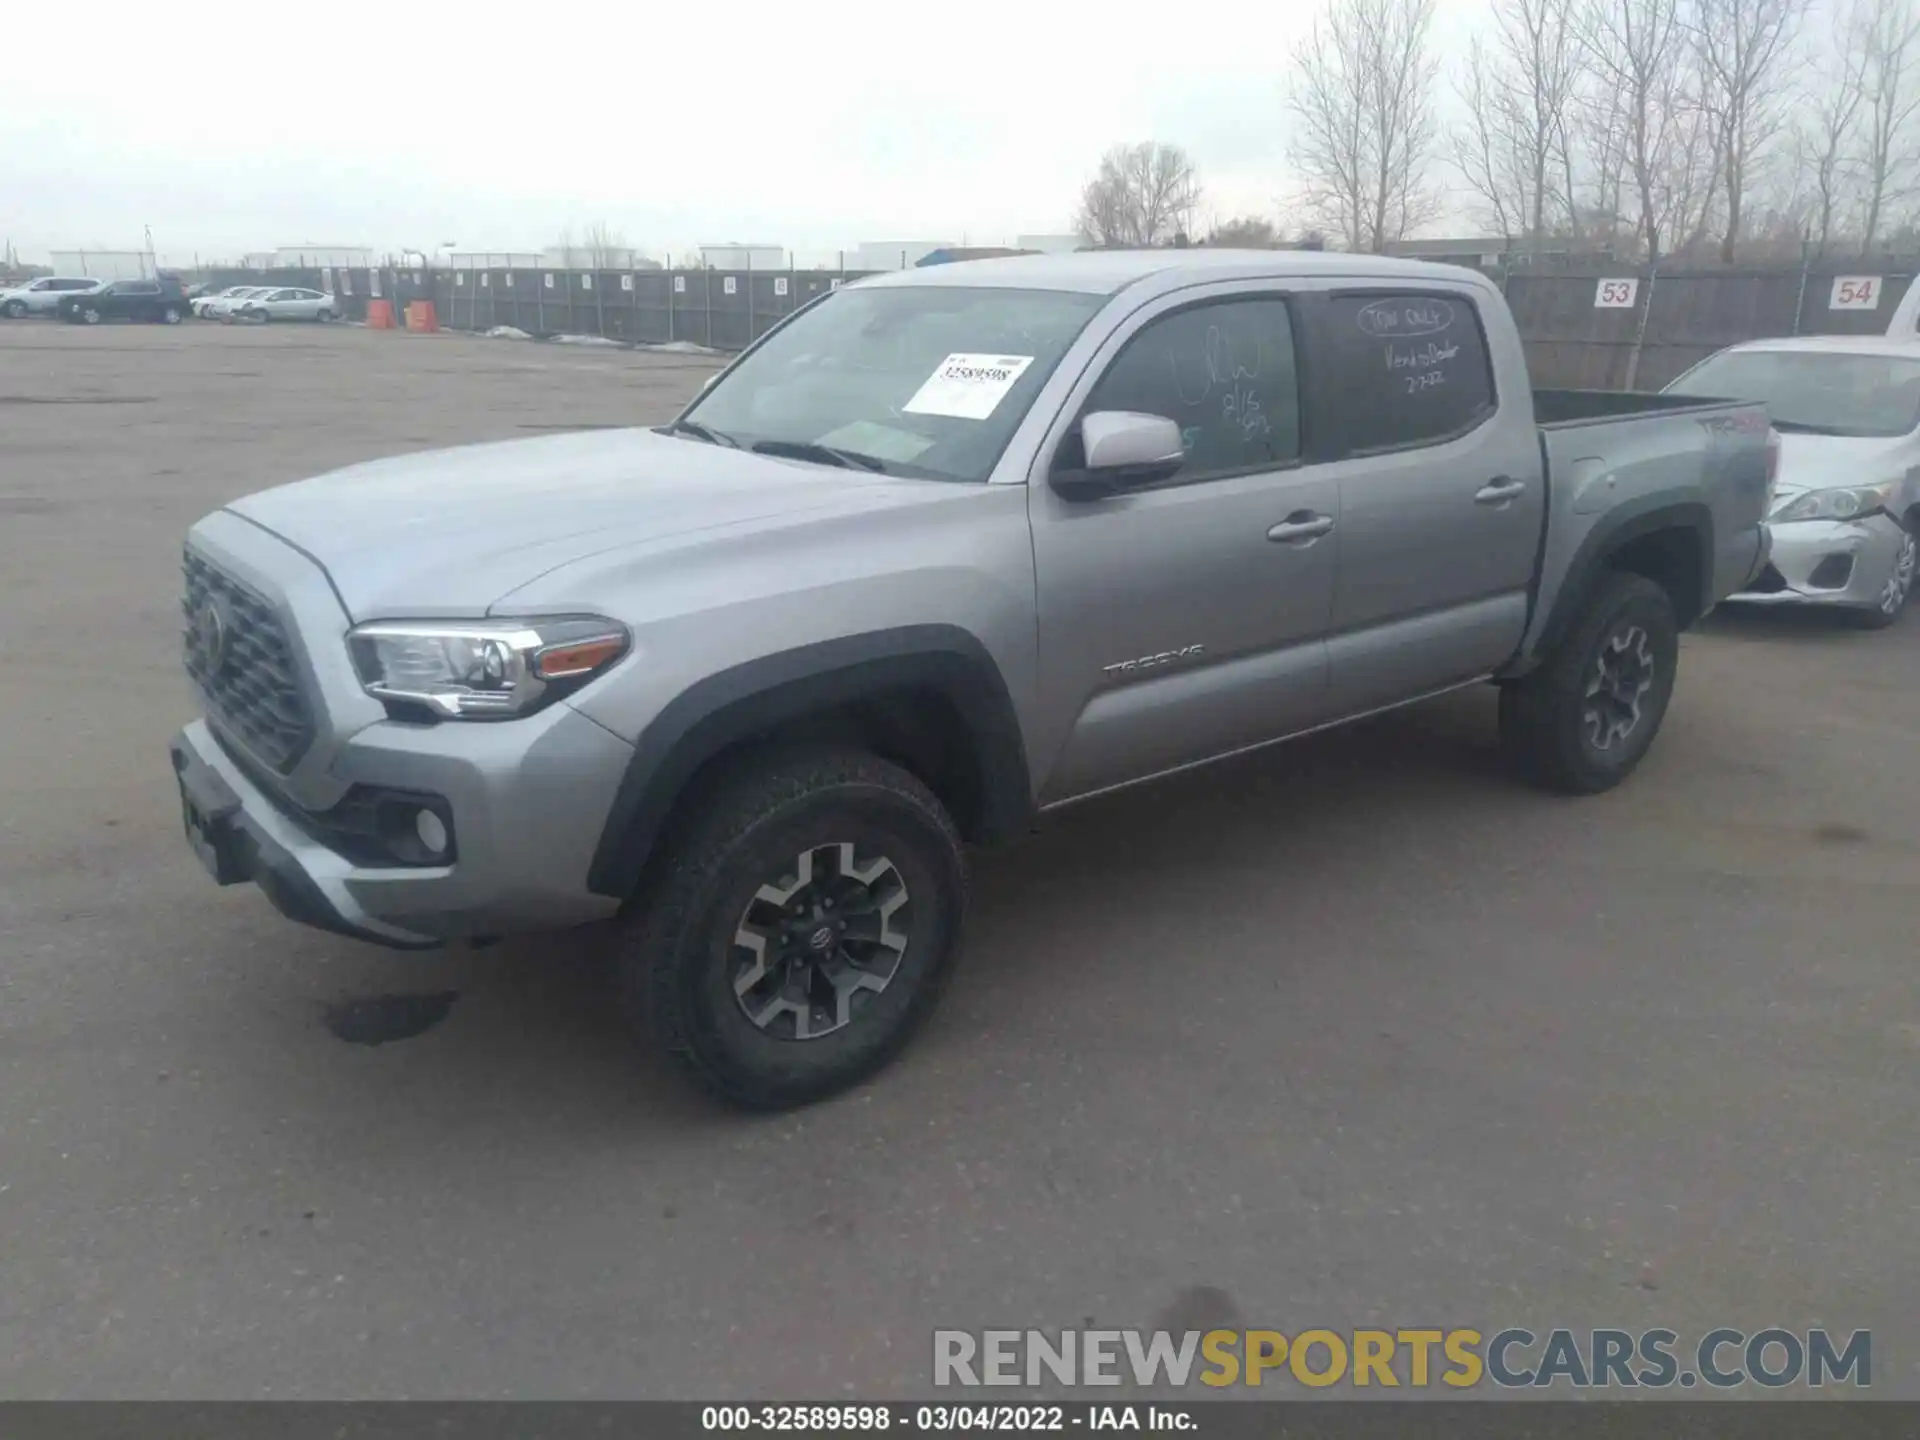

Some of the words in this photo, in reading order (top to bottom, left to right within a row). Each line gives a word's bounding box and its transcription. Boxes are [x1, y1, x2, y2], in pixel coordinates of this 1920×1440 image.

[1602, 283, 1630, 303] 53
[1838, 281, 1873, 304] 54
[1102, 644, 1205, 676] TACOMA
